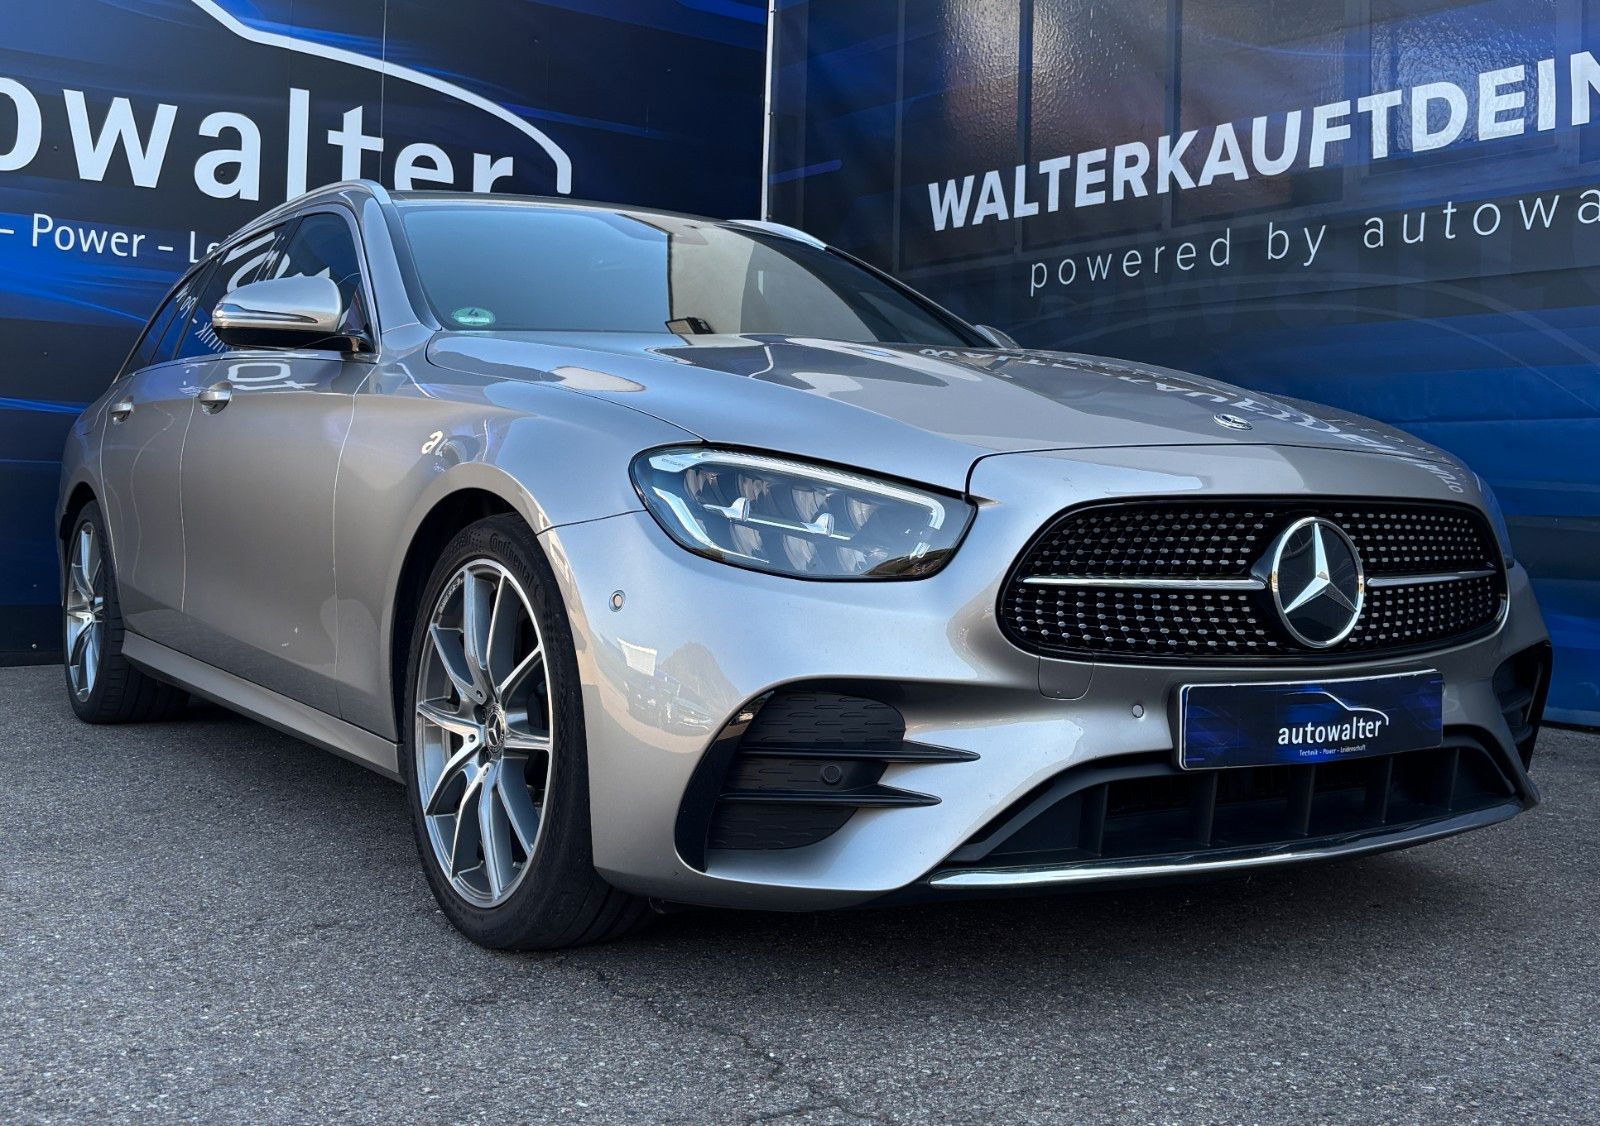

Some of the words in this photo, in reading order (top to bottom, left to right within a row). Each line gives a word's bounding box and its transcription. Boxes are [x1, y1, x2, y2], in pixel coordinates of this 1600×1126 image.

[32, 213, 145, 257] Power
[1030, 228, 1231, 296] powered
[1267, 222, 1326, 266] by
[1364, 189, 1600, 248] autowa
[1278, 716, 1381, 745] autowalter
[1299, 748, 1318, 756] Technik
